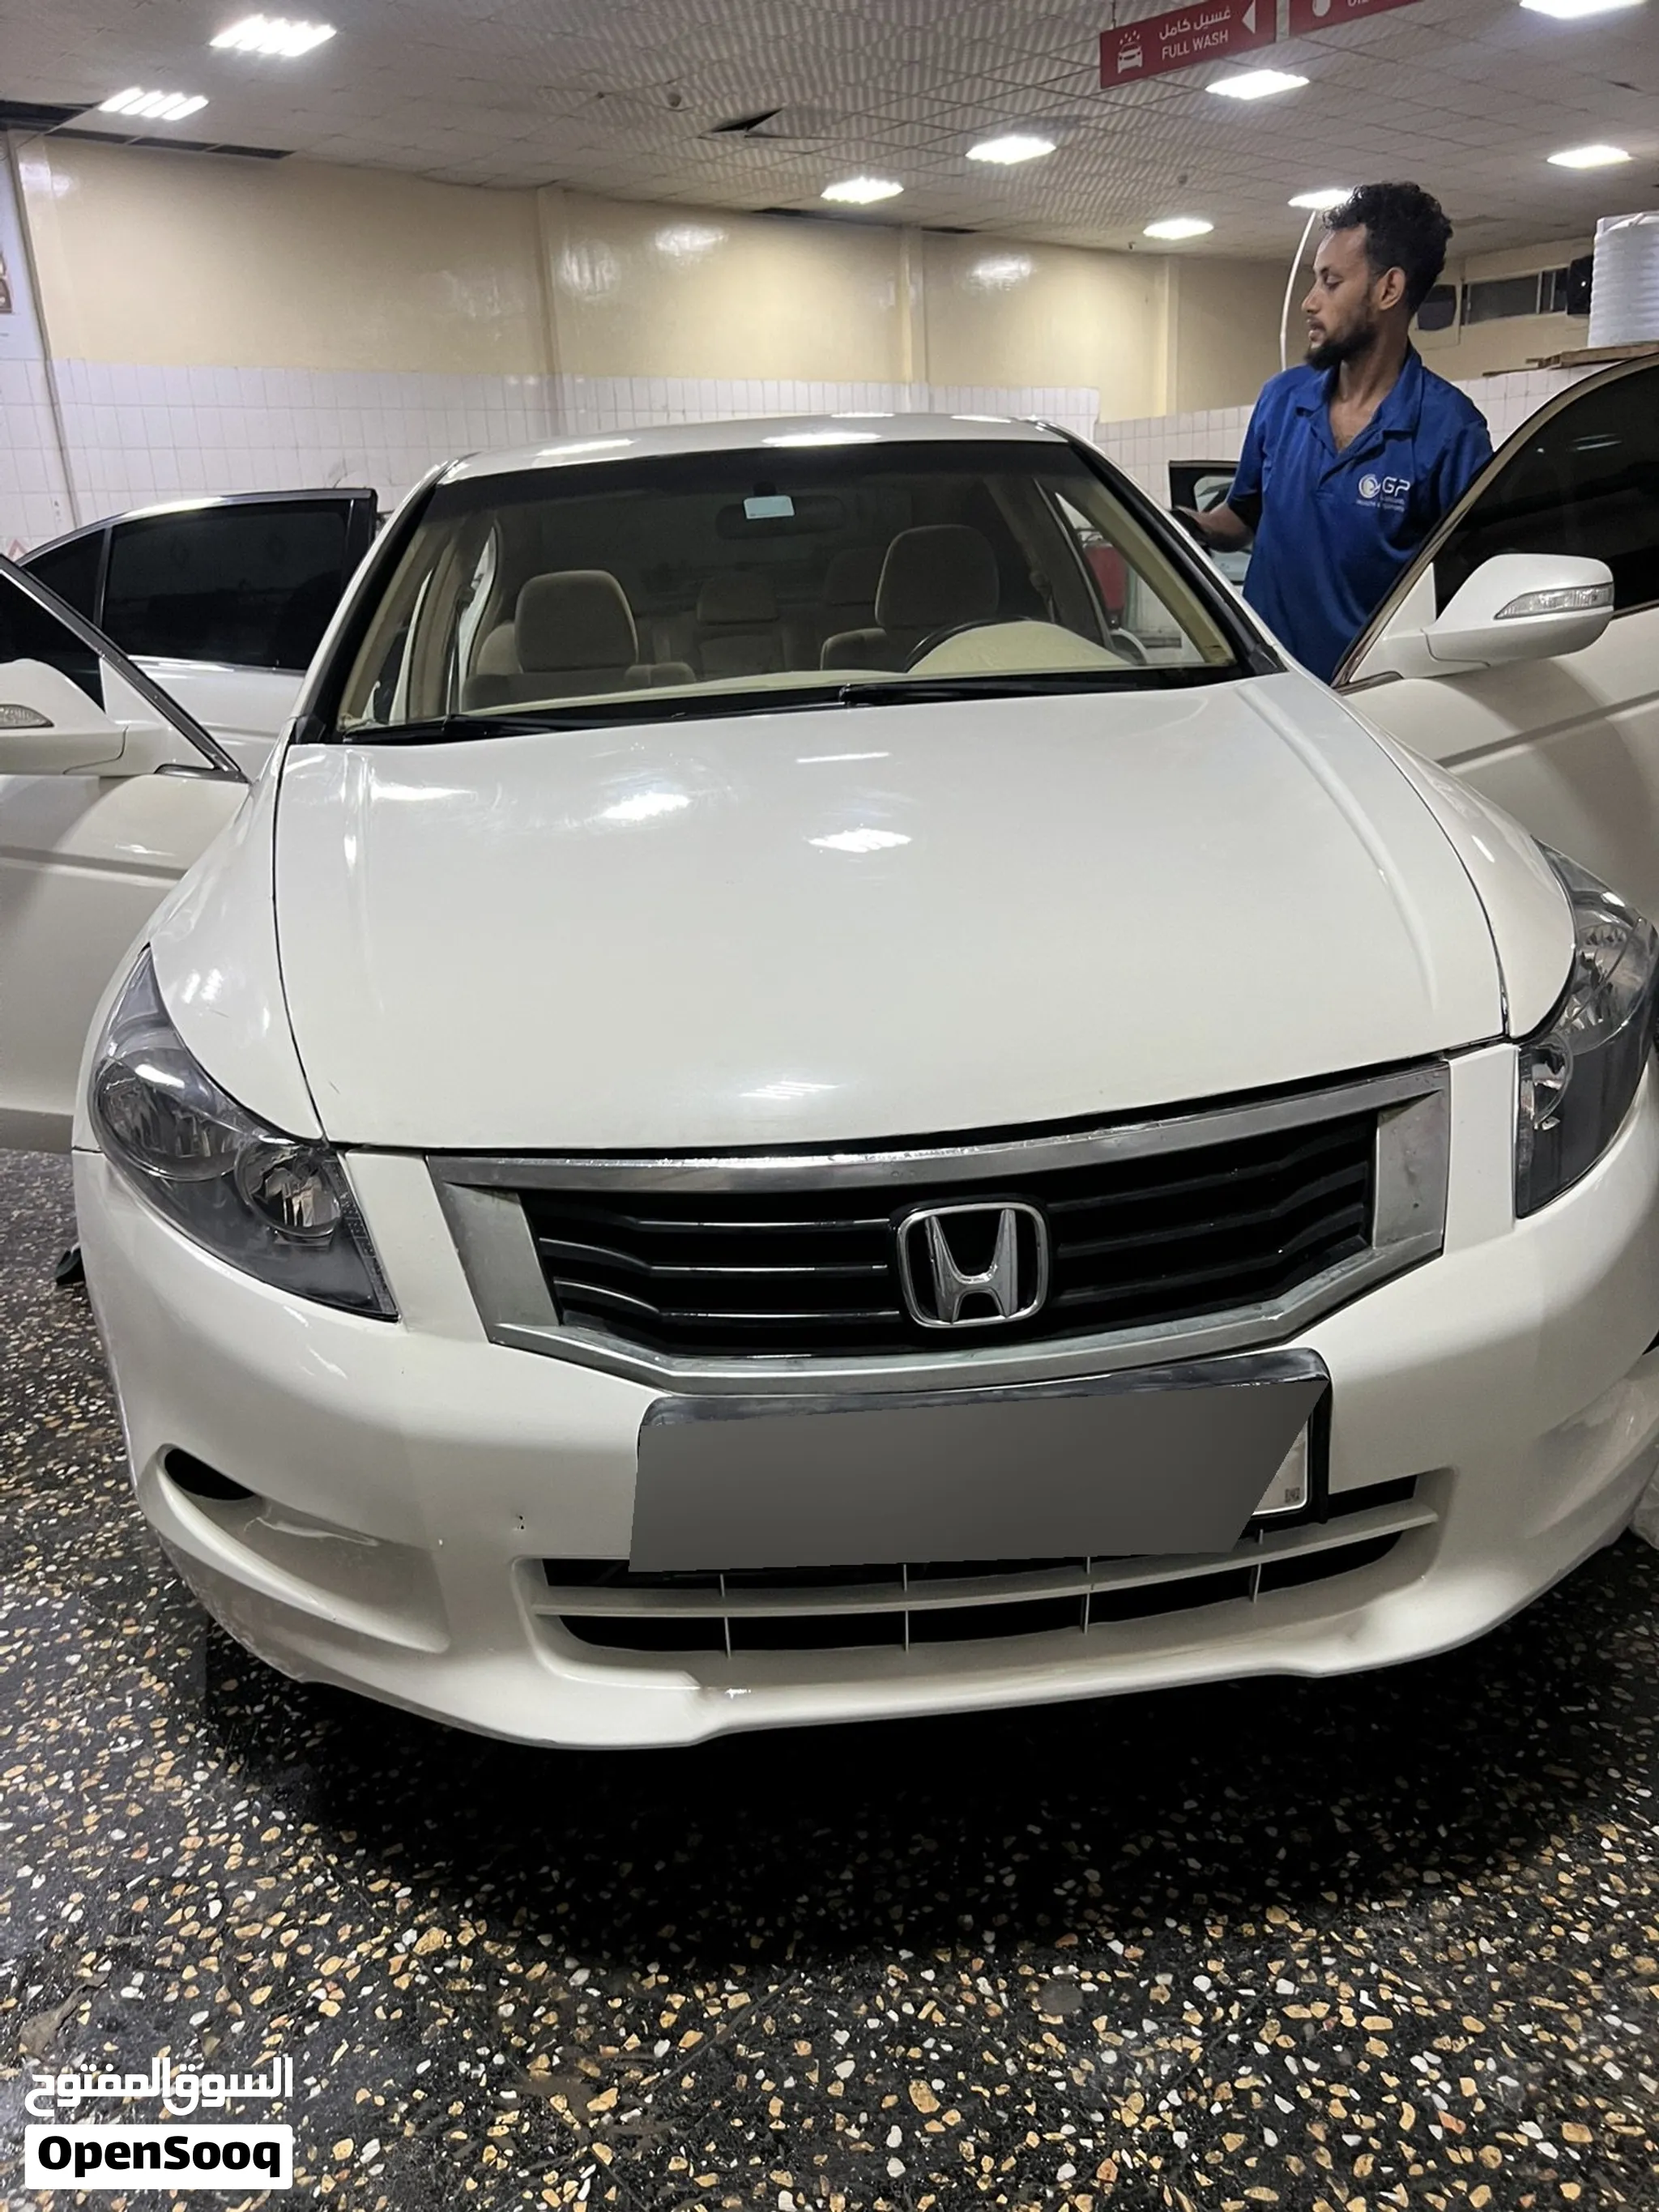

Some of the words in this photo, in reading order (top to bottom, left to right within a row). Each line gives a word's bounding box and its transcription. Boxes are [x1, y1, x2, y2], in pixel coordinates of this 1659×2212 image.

[1159, 18, 1191, 40] كامل
[1193, 5, 1231, 30] غسيل
[1162, 40, 1190, 61] FULL
[1192, 29, 1229, 51] WASH
